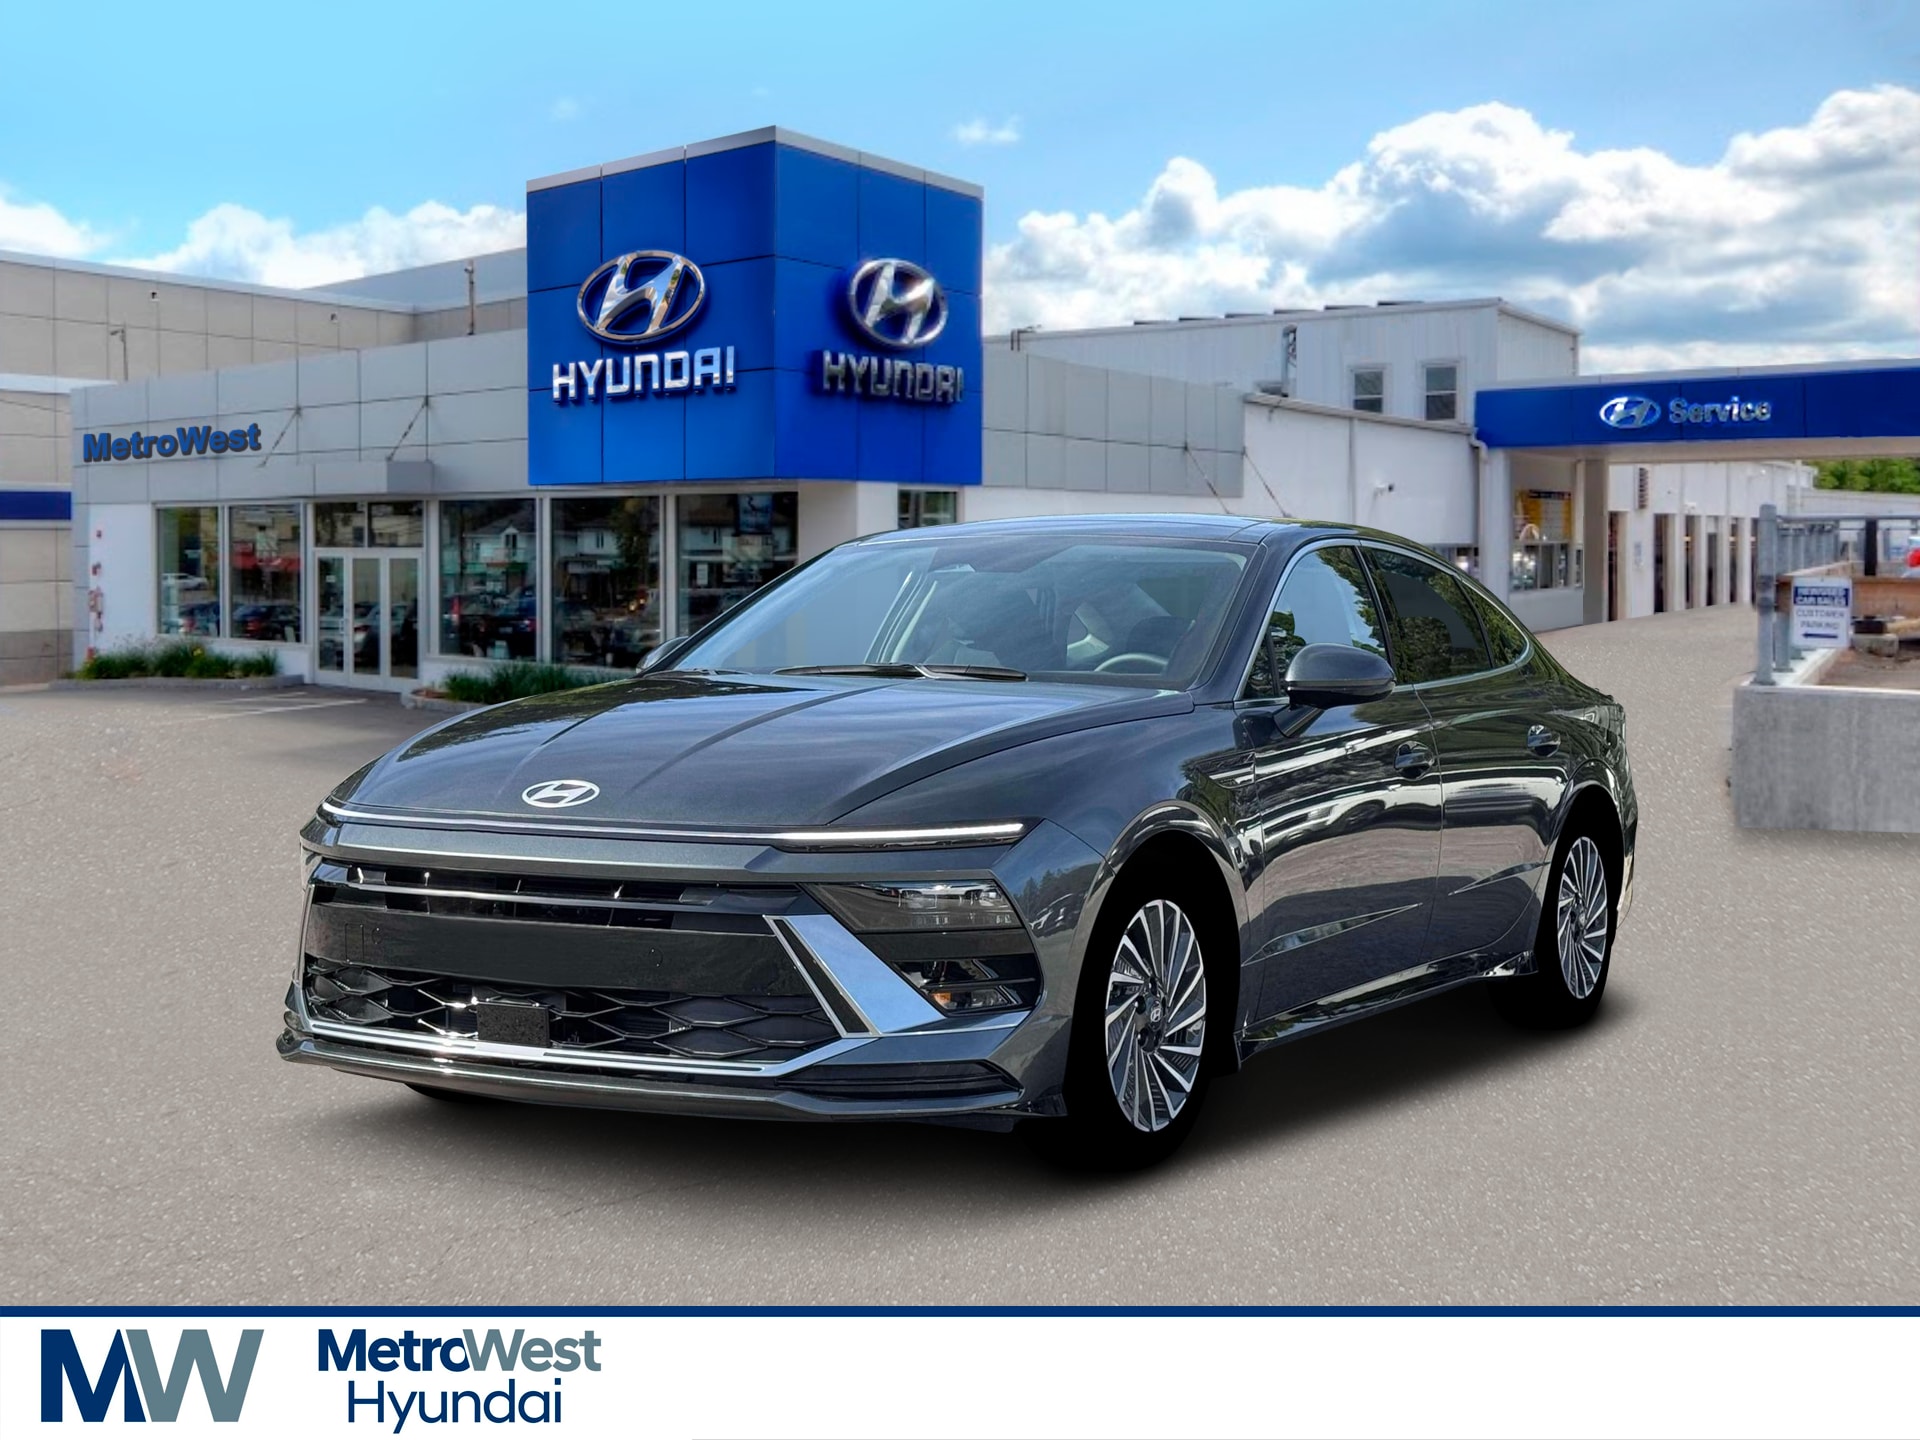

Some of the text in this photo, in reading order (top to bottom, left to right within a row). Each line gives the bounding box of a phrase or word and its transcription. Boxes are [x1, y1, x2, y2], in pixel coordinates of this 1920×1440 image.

[552, 345, 735, 401] HYUNDAI
[821, 349, 964, 403] HYUNDAI
[1669, 395, 1772, 423] Service
[83, 422, 262, 463] MetroWest
[1796, 608, 1845, 618] CUSTOMER
[1800, 620, 1840, 630] PARKING
